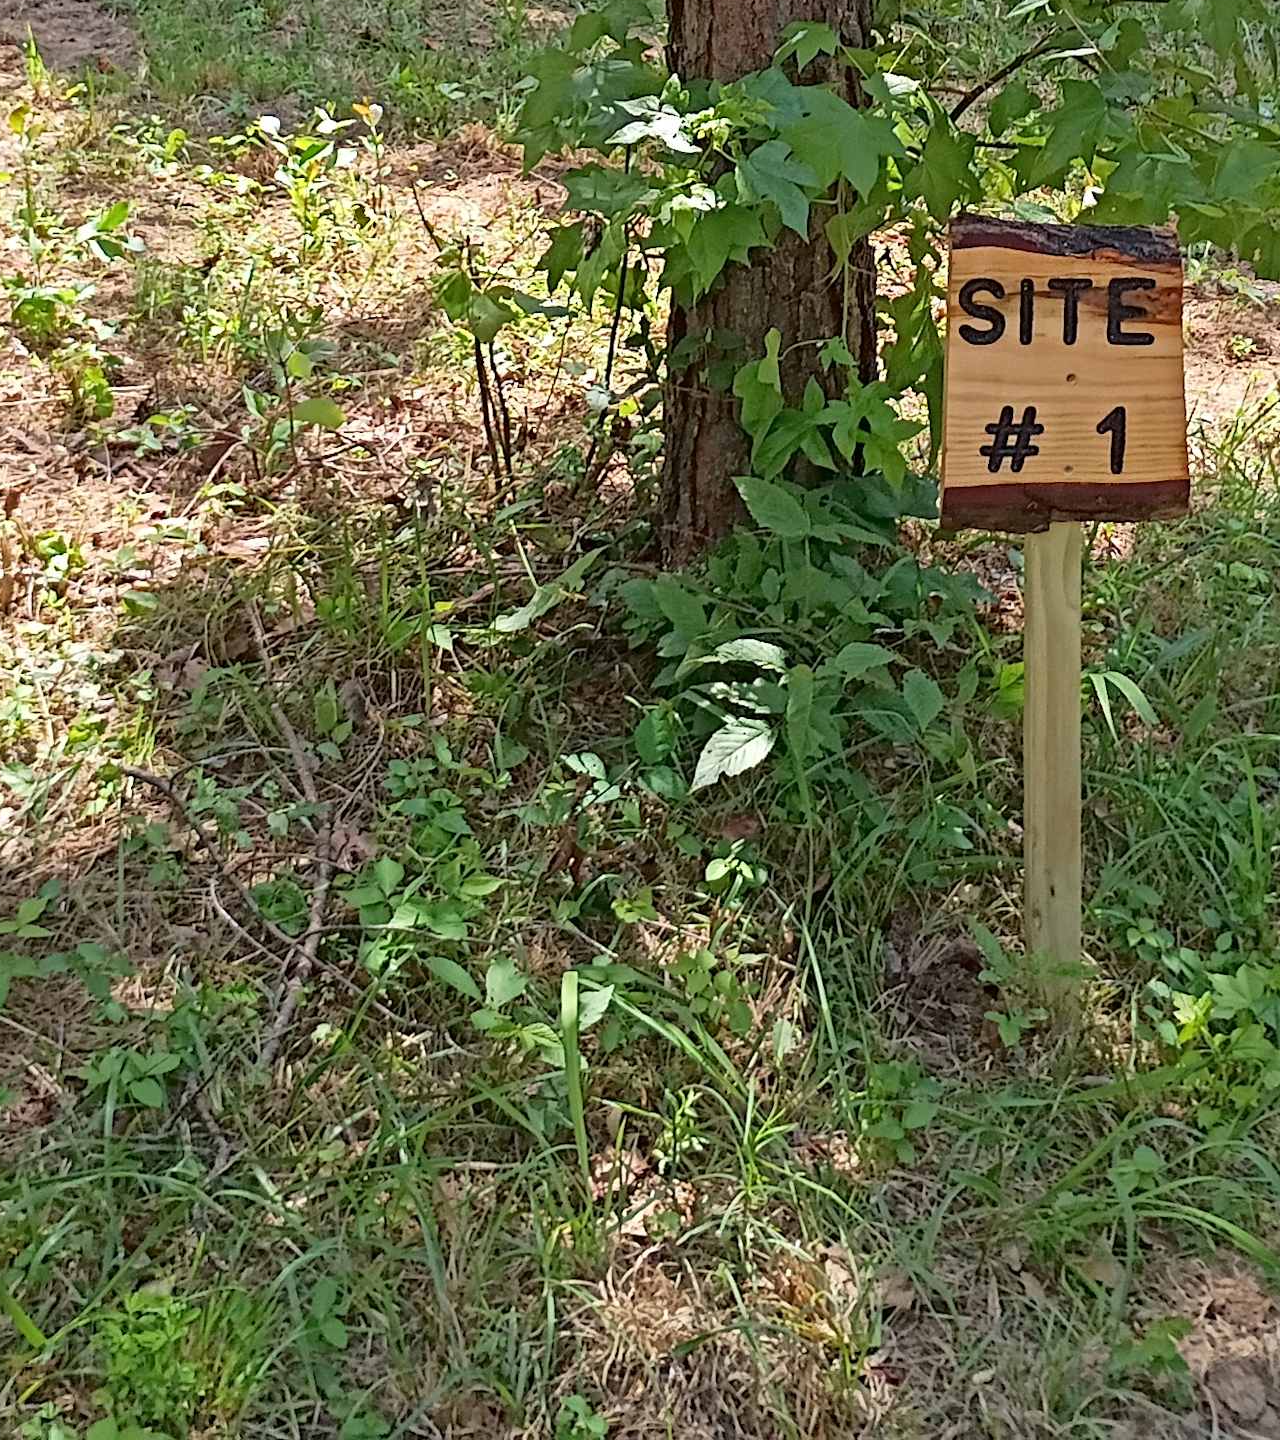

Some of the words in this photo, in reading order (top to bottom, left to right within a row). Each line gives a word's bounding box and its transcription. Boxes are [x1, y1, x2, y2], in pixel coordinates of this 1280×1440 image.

[958, 277, 1157, 346] SITE
[978, 405, 1045, 474] #
[1095, 405, 1127, 475] 1
